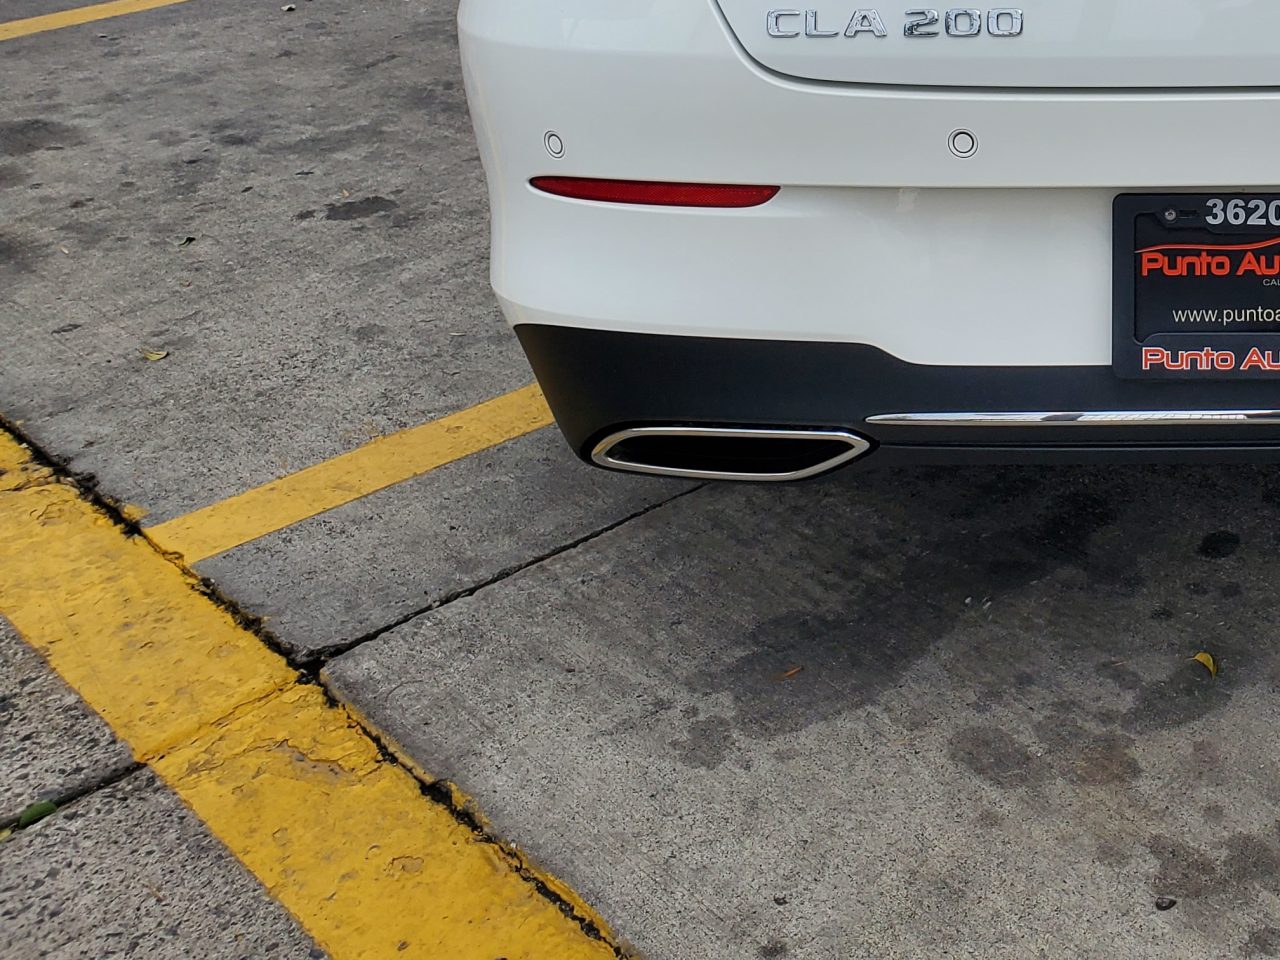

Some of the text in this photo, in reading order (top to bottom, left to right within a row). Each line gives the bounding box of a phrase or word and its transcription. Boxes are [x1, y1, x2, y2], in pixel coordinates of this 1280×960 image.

[766, 8, 1025, 38] CLA 200
[1141, 251, 1230, 277] Punto
[1142, 346, 1235, 371] Punto
